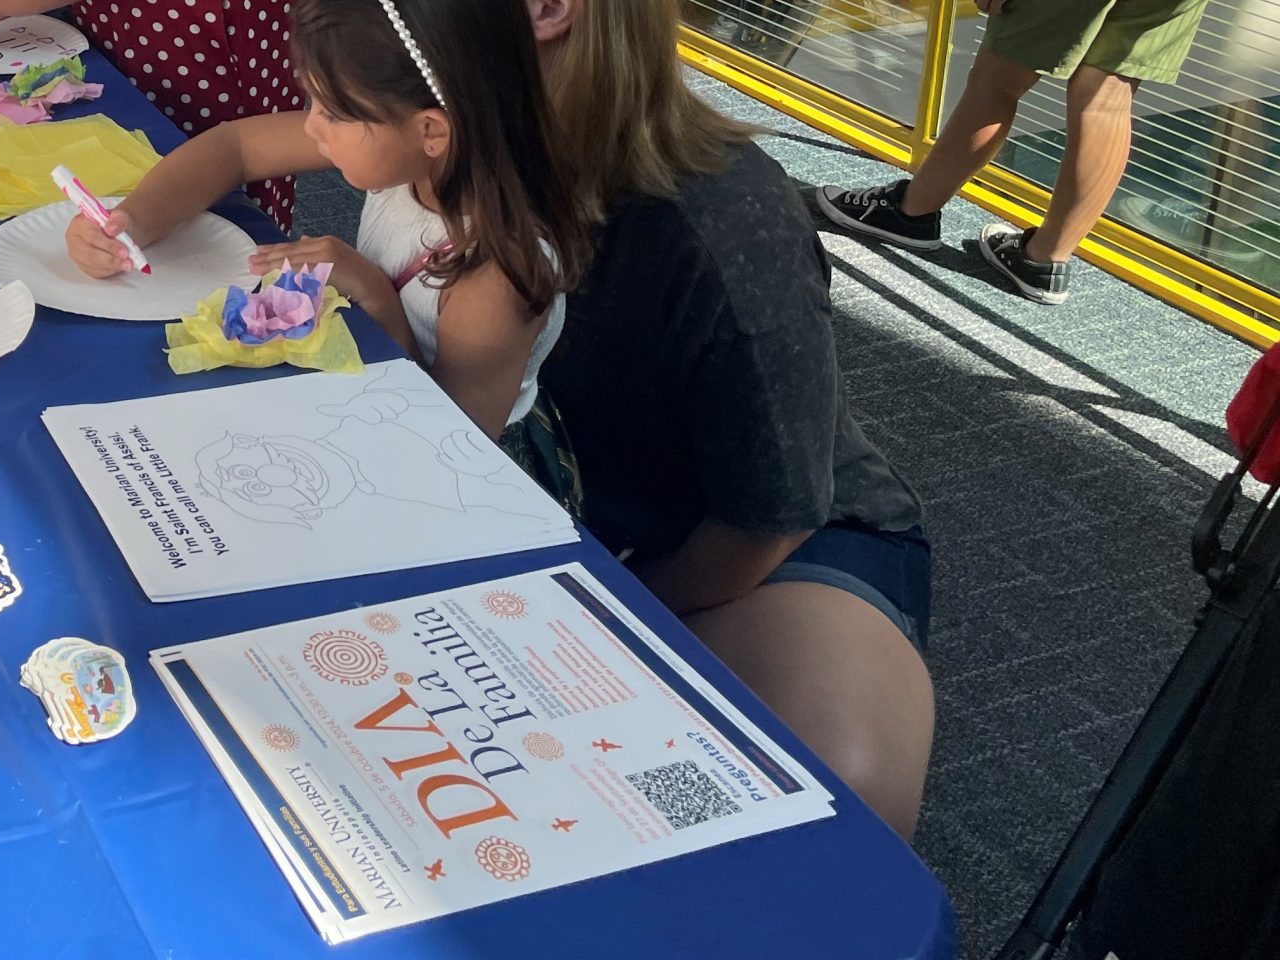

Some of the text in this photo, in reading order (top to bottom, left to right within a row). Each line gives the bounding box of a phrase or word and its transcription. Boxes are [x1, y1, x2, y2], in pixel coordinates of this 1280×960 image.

[109, 432, 136, 459] Assisi.
[80, 427, 186, 568] Welcome to Marian University!
[130, 425, 229, 555] You can call me Little Frank.
[139, 473, 169, 507] Francis
[162, 509, 189, 535] Saint
[184, 538, 203, 554] I'm
[414, 608, 536, 725] Familia
[417, 670, 528, 783] De La
[344, 741, 373, 771] Octubre
[354, 688, 517, 838] DIA
[687, 732, 767, 801] Preguntas?
[368, 772, 384, 784] de
[710, 769, 741, 798] Escanea
[277, 805, 304, 834] Familias
[286, 766, 350, 842] UNIVERSITY
[297, 834, 312, 846] sus
[333, 798, 384, 861] Indianapolis
[339, 785, 410, 872] Latino Leadership Initiative
[310, 852, 346, 894] Estudiantes
[347, 847, 402, 908] MARIAN
[338, 892, 359, 912] Para
